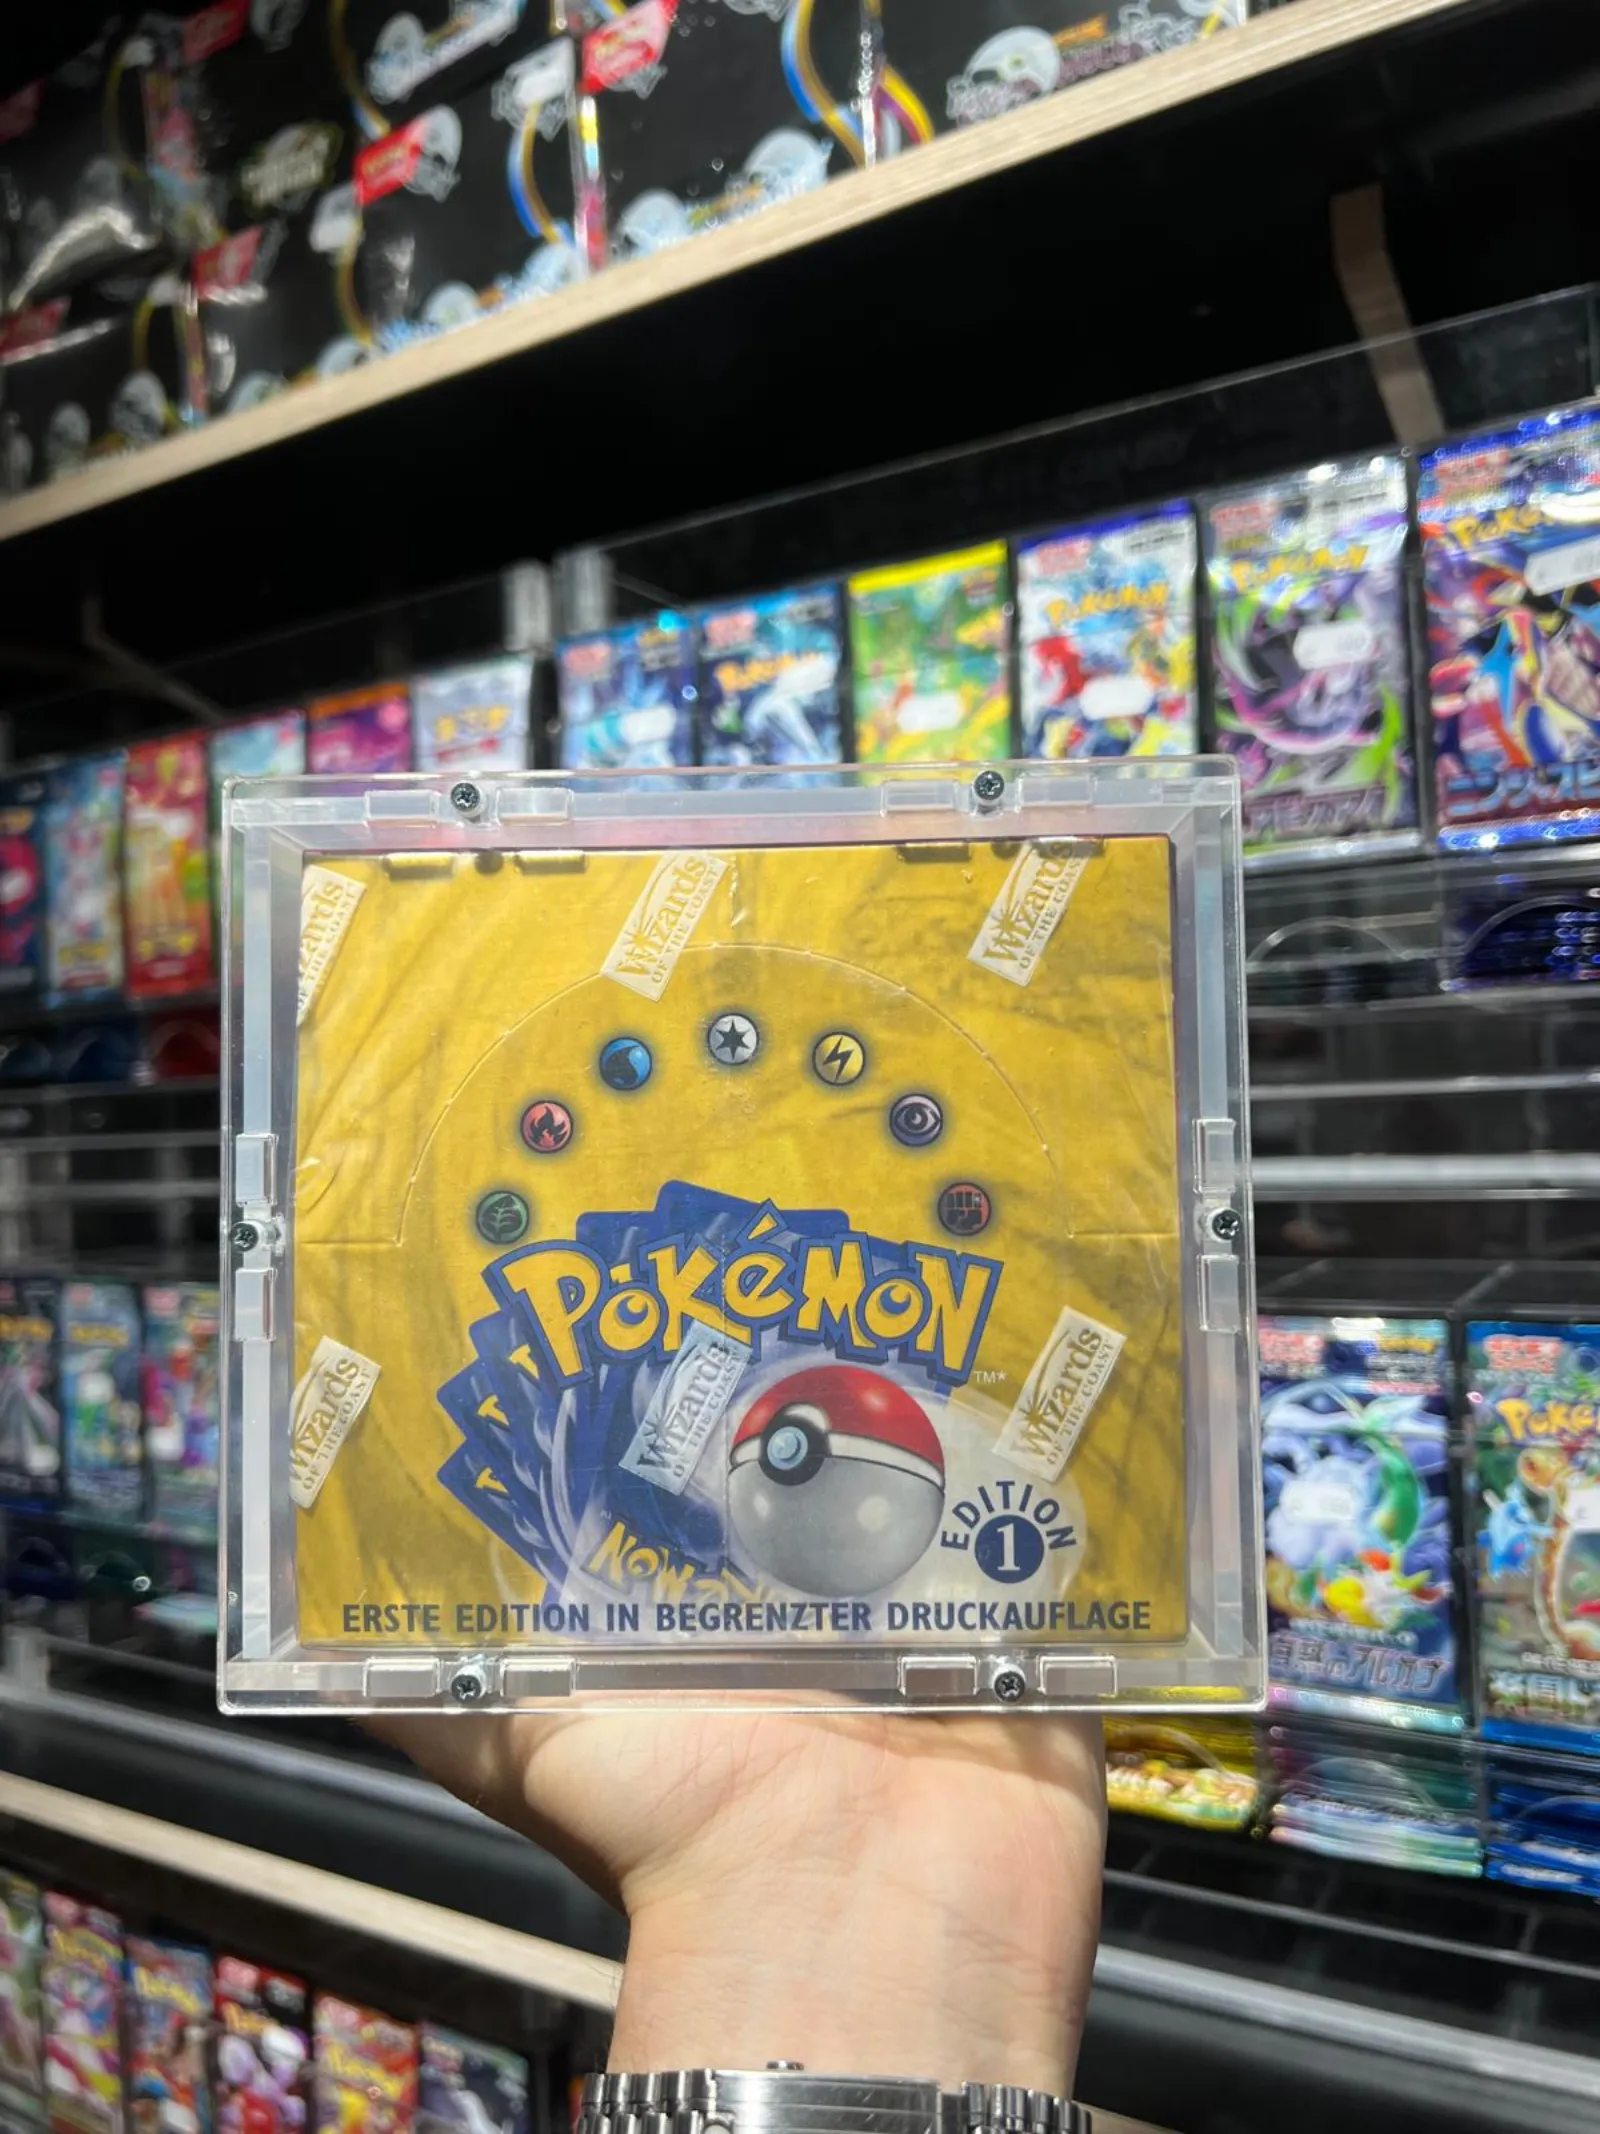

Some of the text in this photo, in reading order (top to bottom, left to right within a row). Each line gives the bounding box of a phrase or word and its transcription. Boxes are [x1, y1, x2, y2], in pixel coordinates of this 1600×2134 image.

[616, 856, 707, 975] Wizards
[652, 960, 668, 984] OF
[686, 863, 719, 919] COAST
[1019, 850, 1083, 969] OF THE COAS
[303, 1366, 371, 1490] OF THE COAST
[637, 1341, 731, 1469] Wizards
[1009, 1328, 1103, 1456] Wizards
[1047, 1343, 1114, 1465] OF THE COAST
[940, 1480, 1077, 1550] EDITION
[996, 1523, 1020, 1571] 1
[343, 1600, 1151, 1633] ERSTE EDITION IN BEGRENZTER DRUCKAUFLAGE
